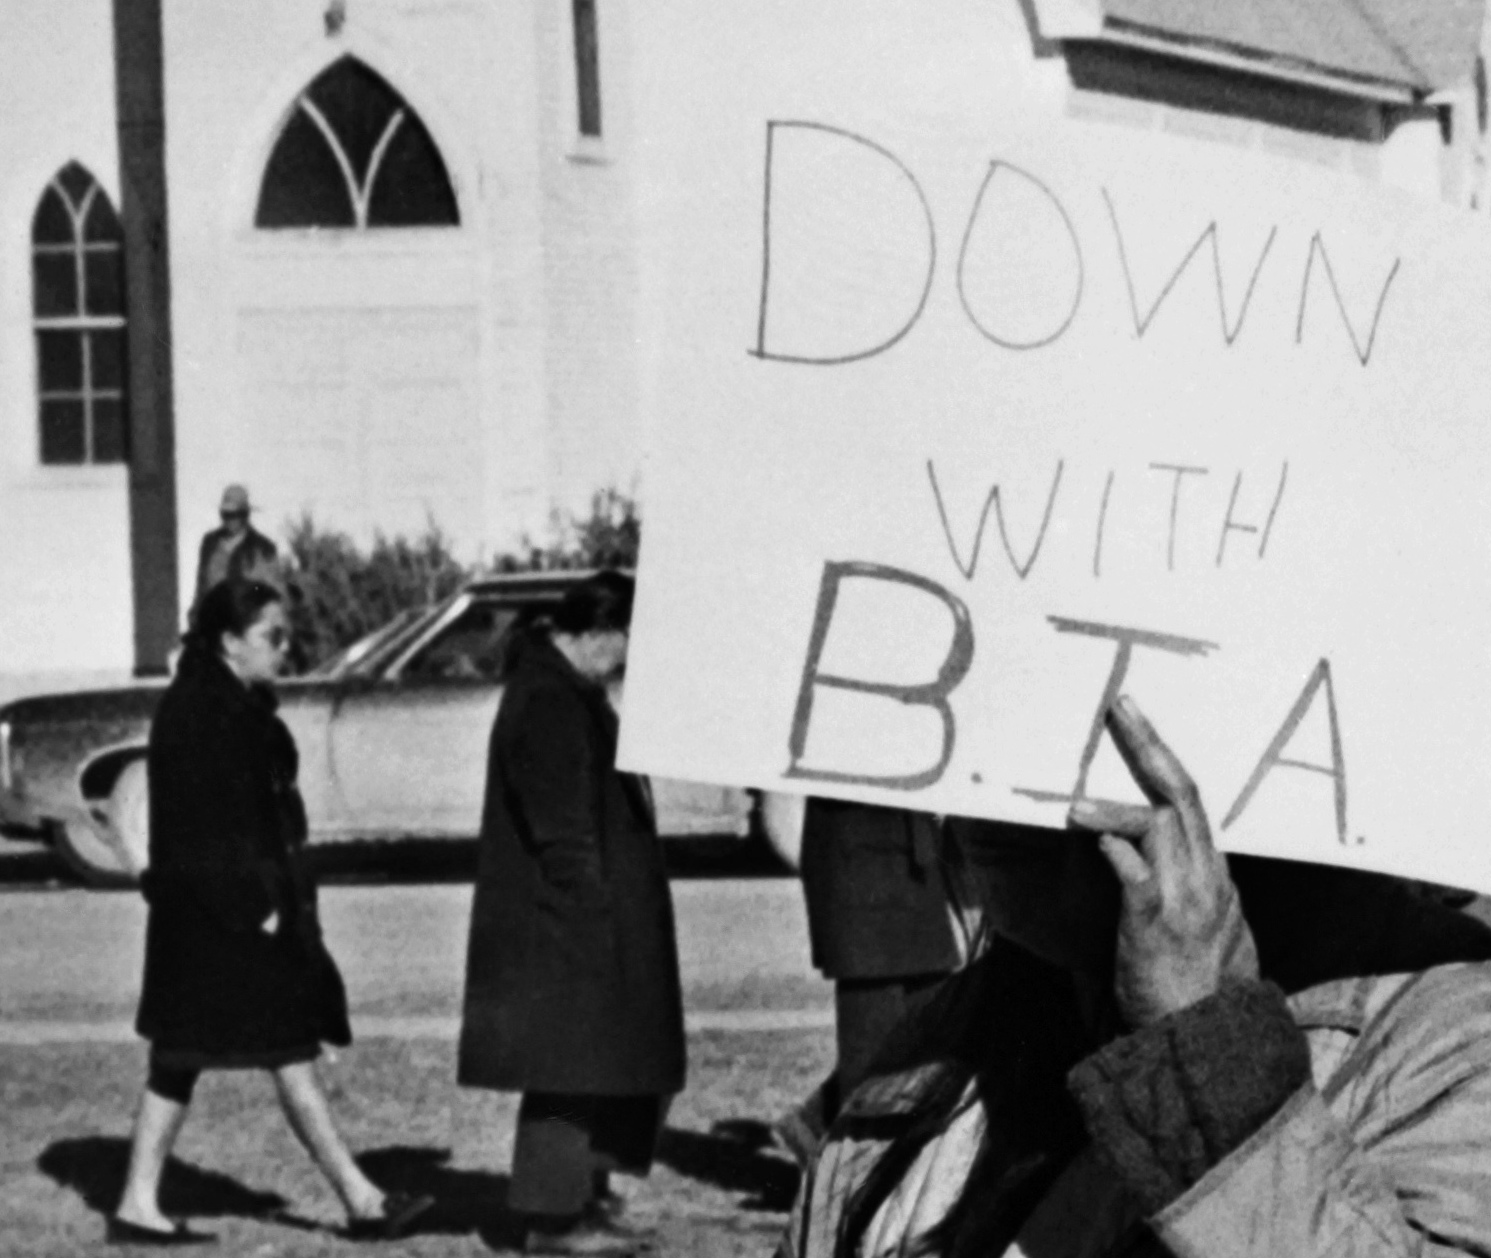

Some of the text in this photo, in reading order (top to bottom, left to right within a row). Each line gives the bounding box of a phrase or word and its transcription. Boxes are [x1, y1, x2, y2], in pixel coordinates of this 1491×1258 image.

[747, 119, 1401, 367] DOWN
[926, 458, 1289, 580] WITH
[781, 560, 1365, 846] B.IA.
